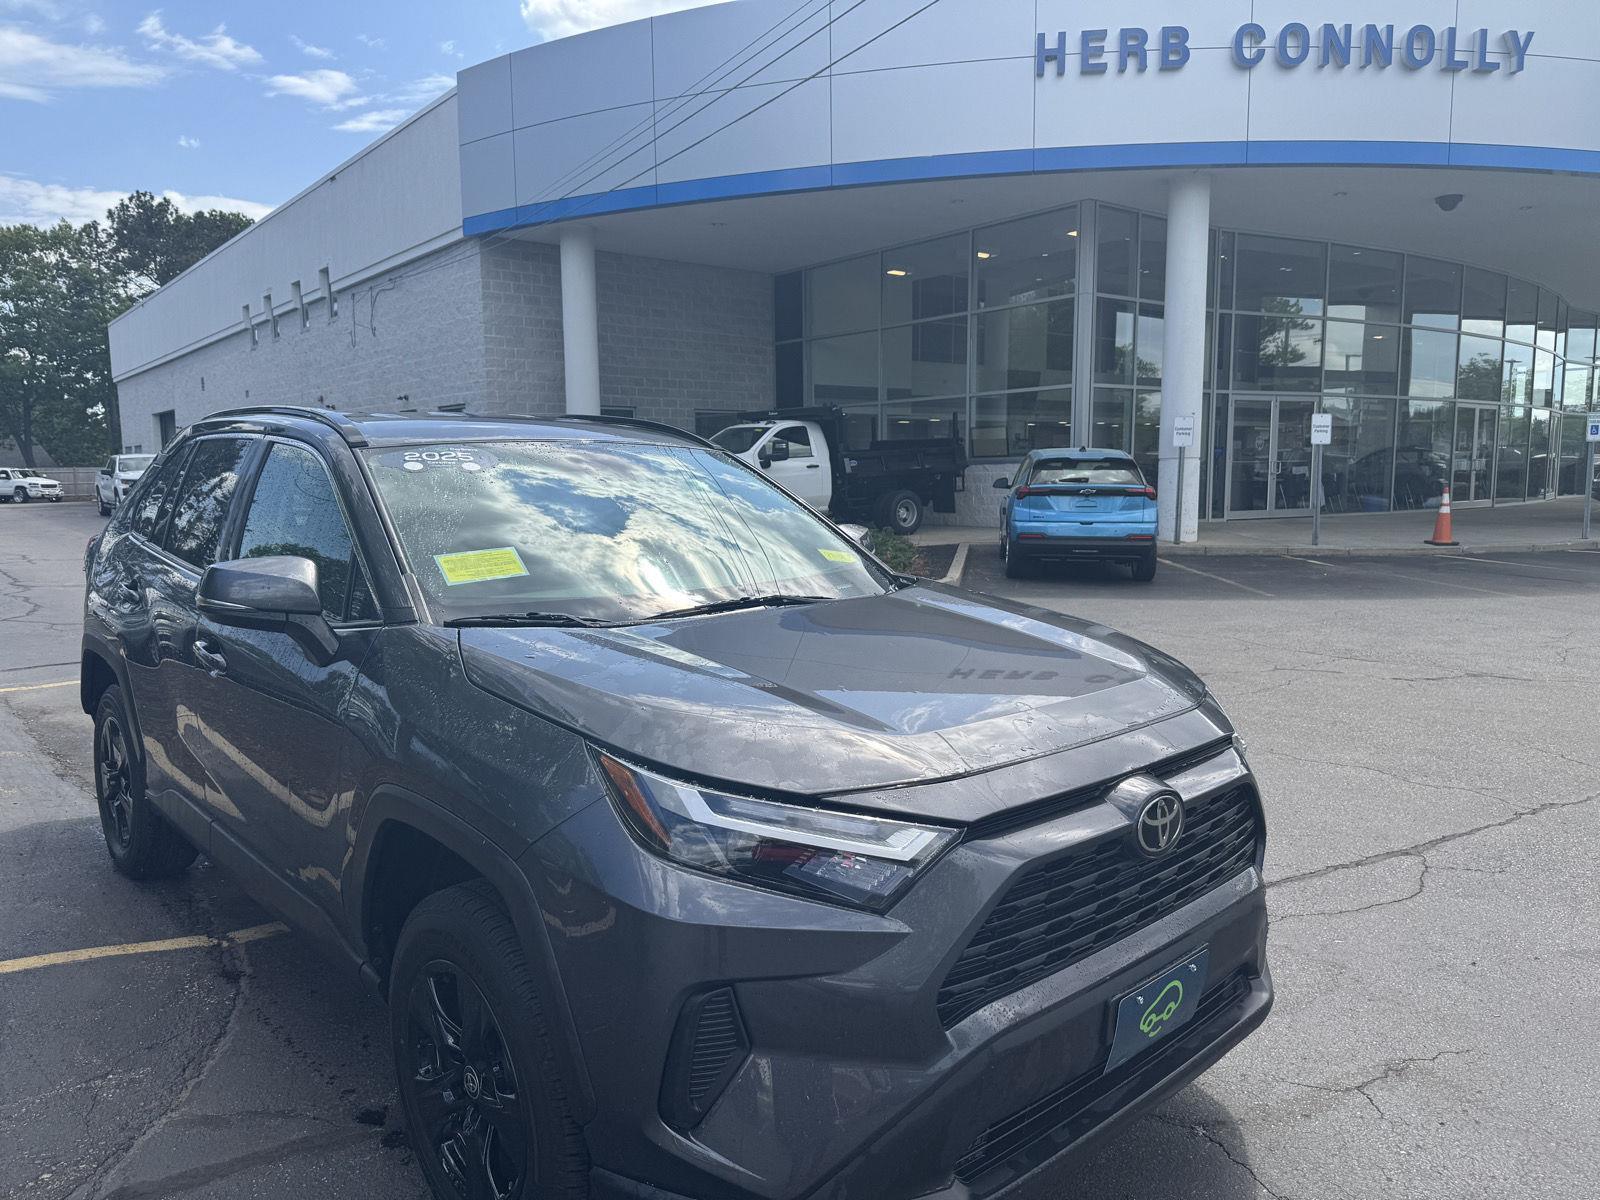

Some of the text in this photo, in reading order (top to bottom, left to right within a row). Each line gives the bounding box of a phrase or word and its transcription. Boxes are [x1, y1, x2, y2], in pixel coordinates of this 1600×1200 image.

[1036, 22, 1535, 77] HERB CONNOLLY
[403, 451, 474, 461] 2025
